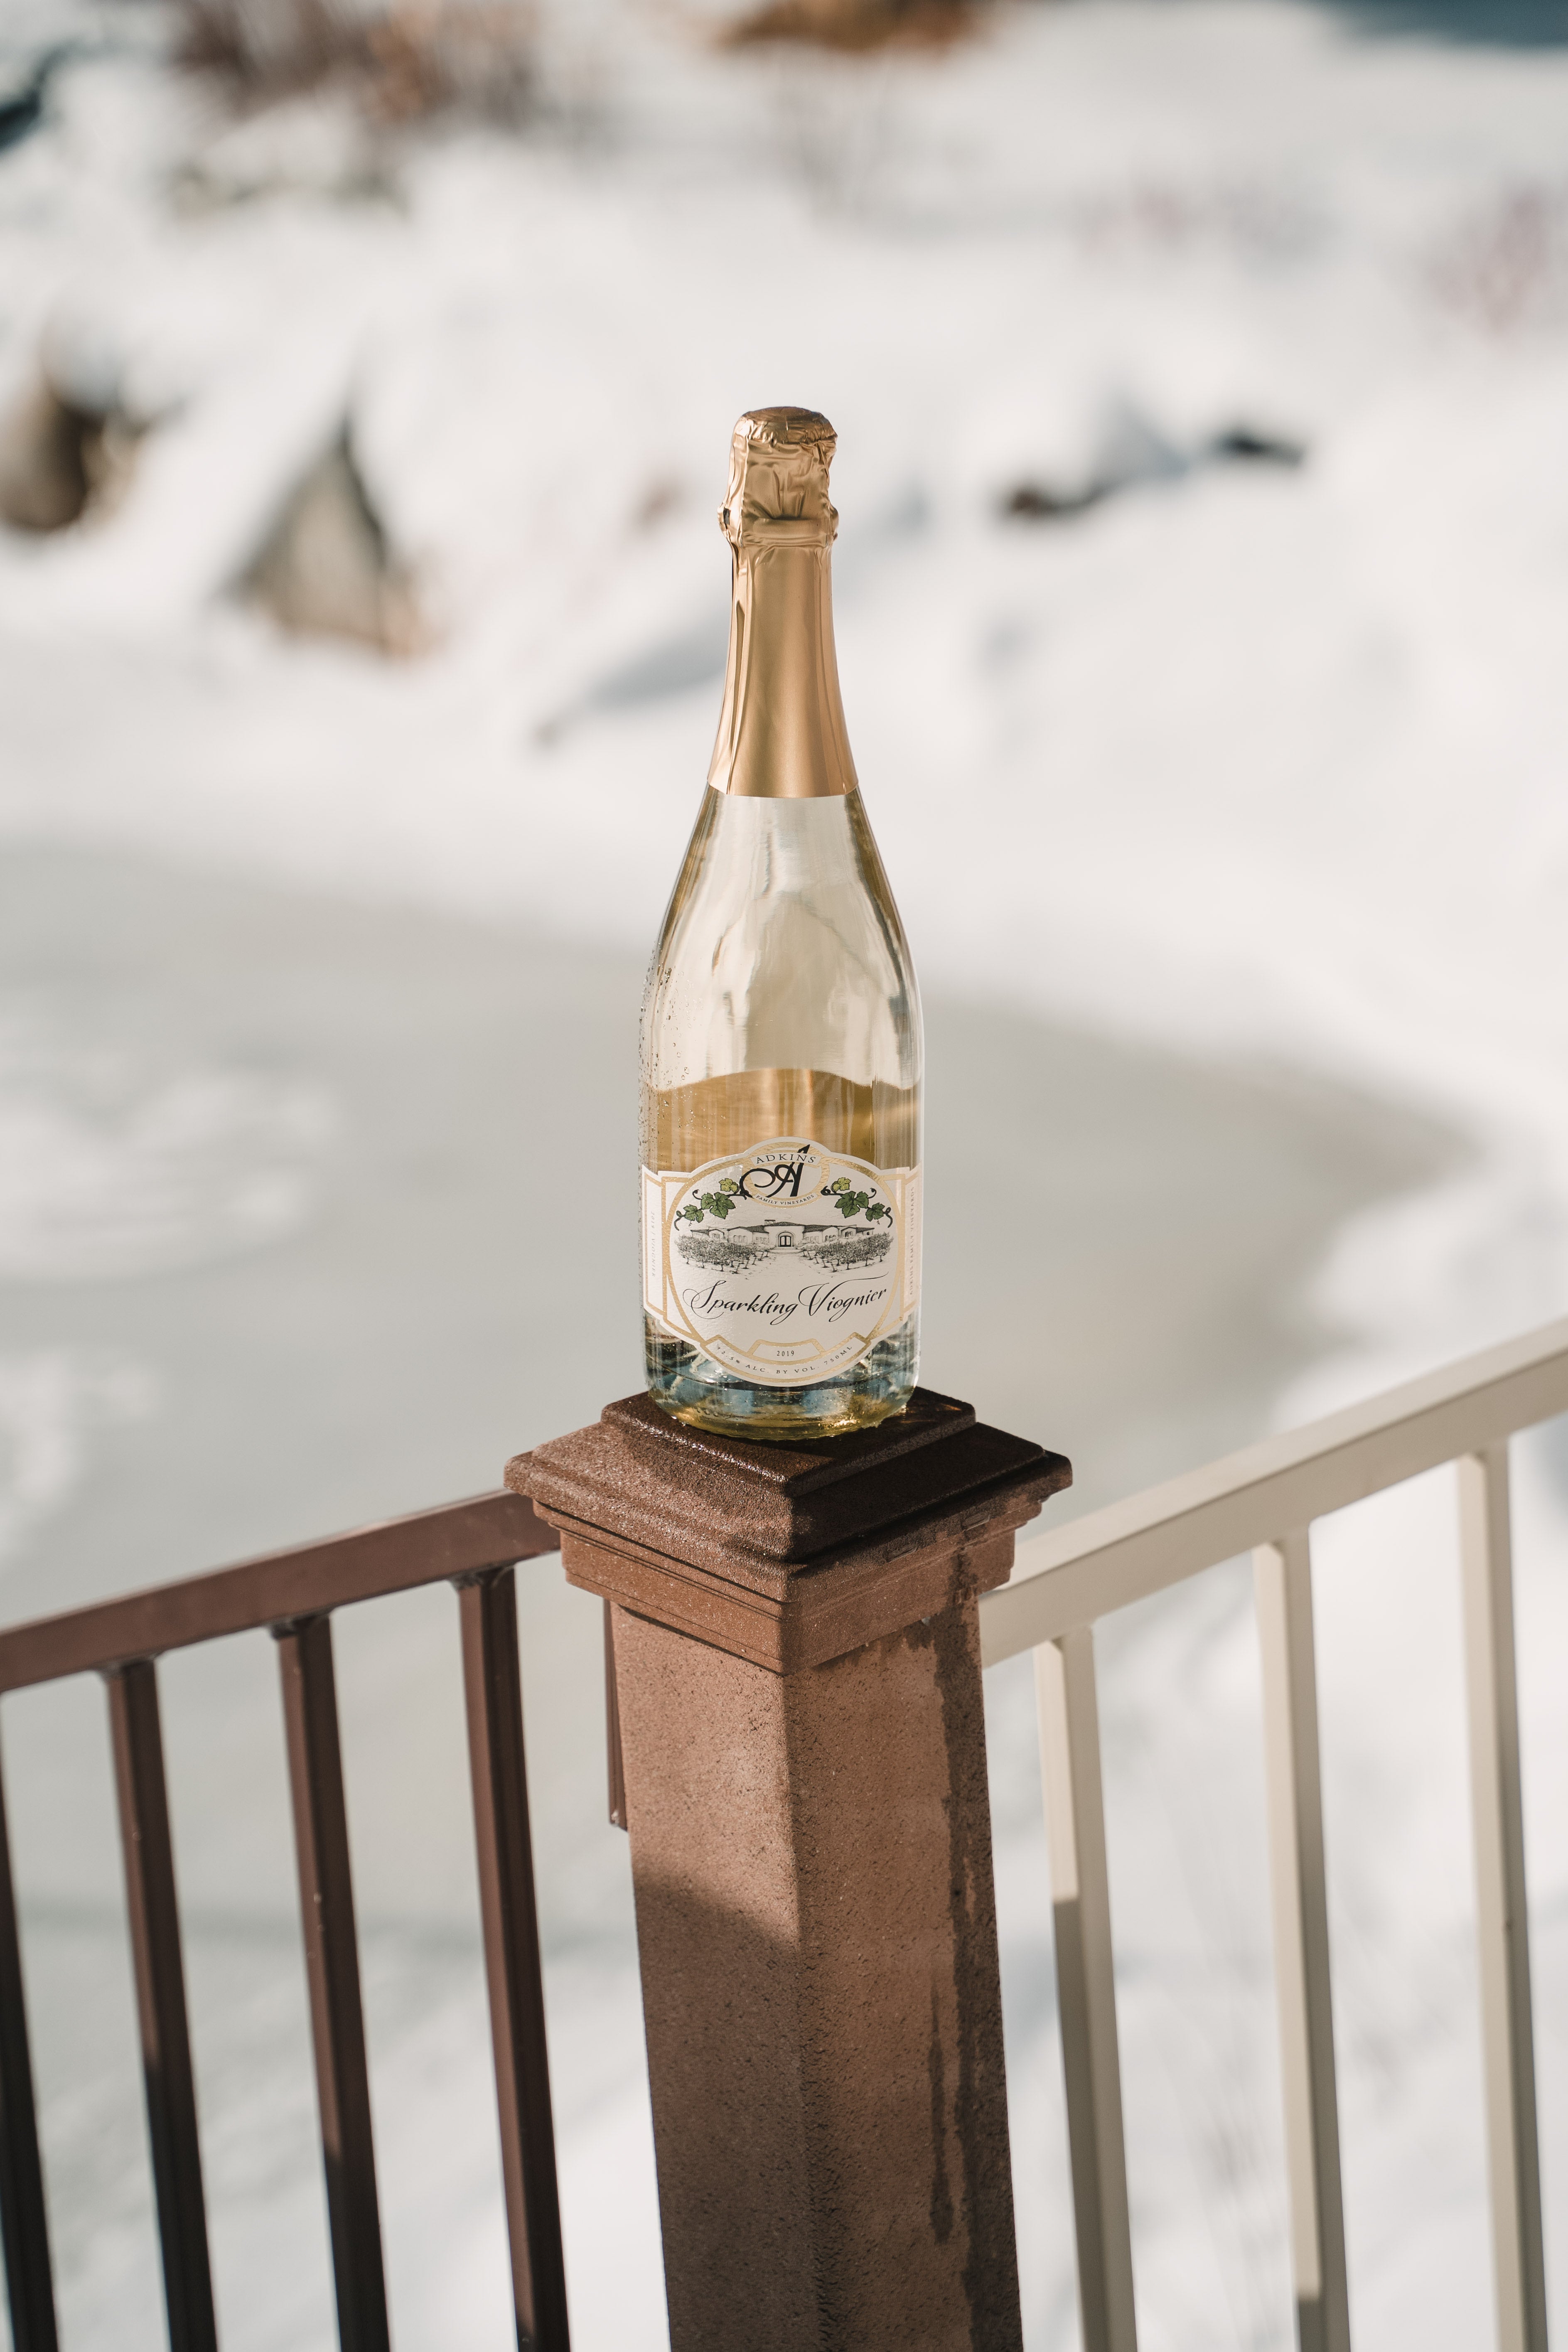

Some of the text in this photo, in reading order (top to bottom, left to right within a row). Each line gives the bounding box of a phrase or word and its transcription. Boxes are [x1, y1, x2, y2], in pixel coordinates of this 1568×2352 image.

[757, 1154, 816, 1164] ADKINS
[756, 1194, 814, 1205] FAMILY VINEYARDS
[683, 1271, 889, 1325] Sparkling Viognier
[746, 1364, 769, 1373] ALC.
[824, 1346, 852, 1364] 750ML
